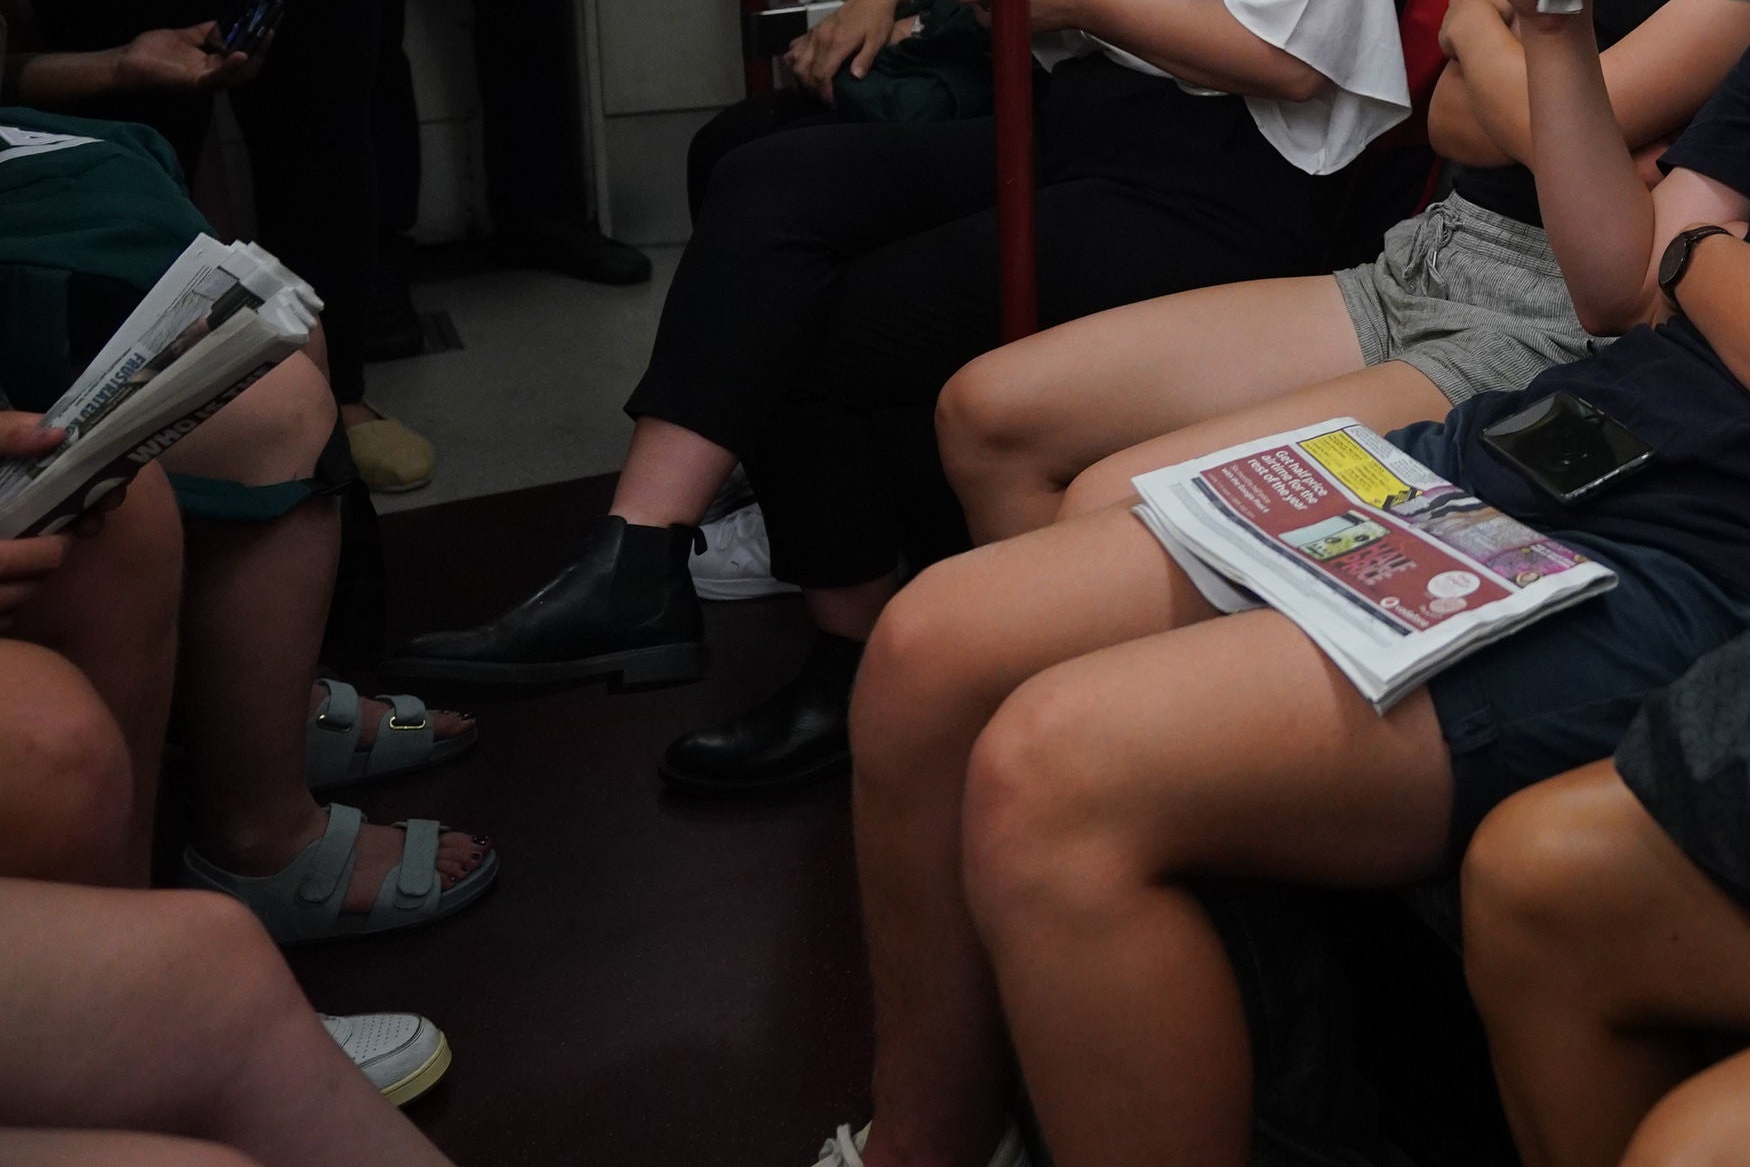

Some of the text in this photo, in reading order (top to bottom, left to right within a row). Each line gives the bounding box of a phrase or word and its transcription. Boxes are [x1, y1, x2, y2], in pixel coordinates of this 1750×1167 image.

[80, 352, 147, 422] FRUSTRATED
[127, 415, 197, 464] WHO
[1247, 458, 1308, 512] rest of the year
[1260, 455, 1317, 505] airtime for the
[1274, 448, 1328, 498] Get half price
